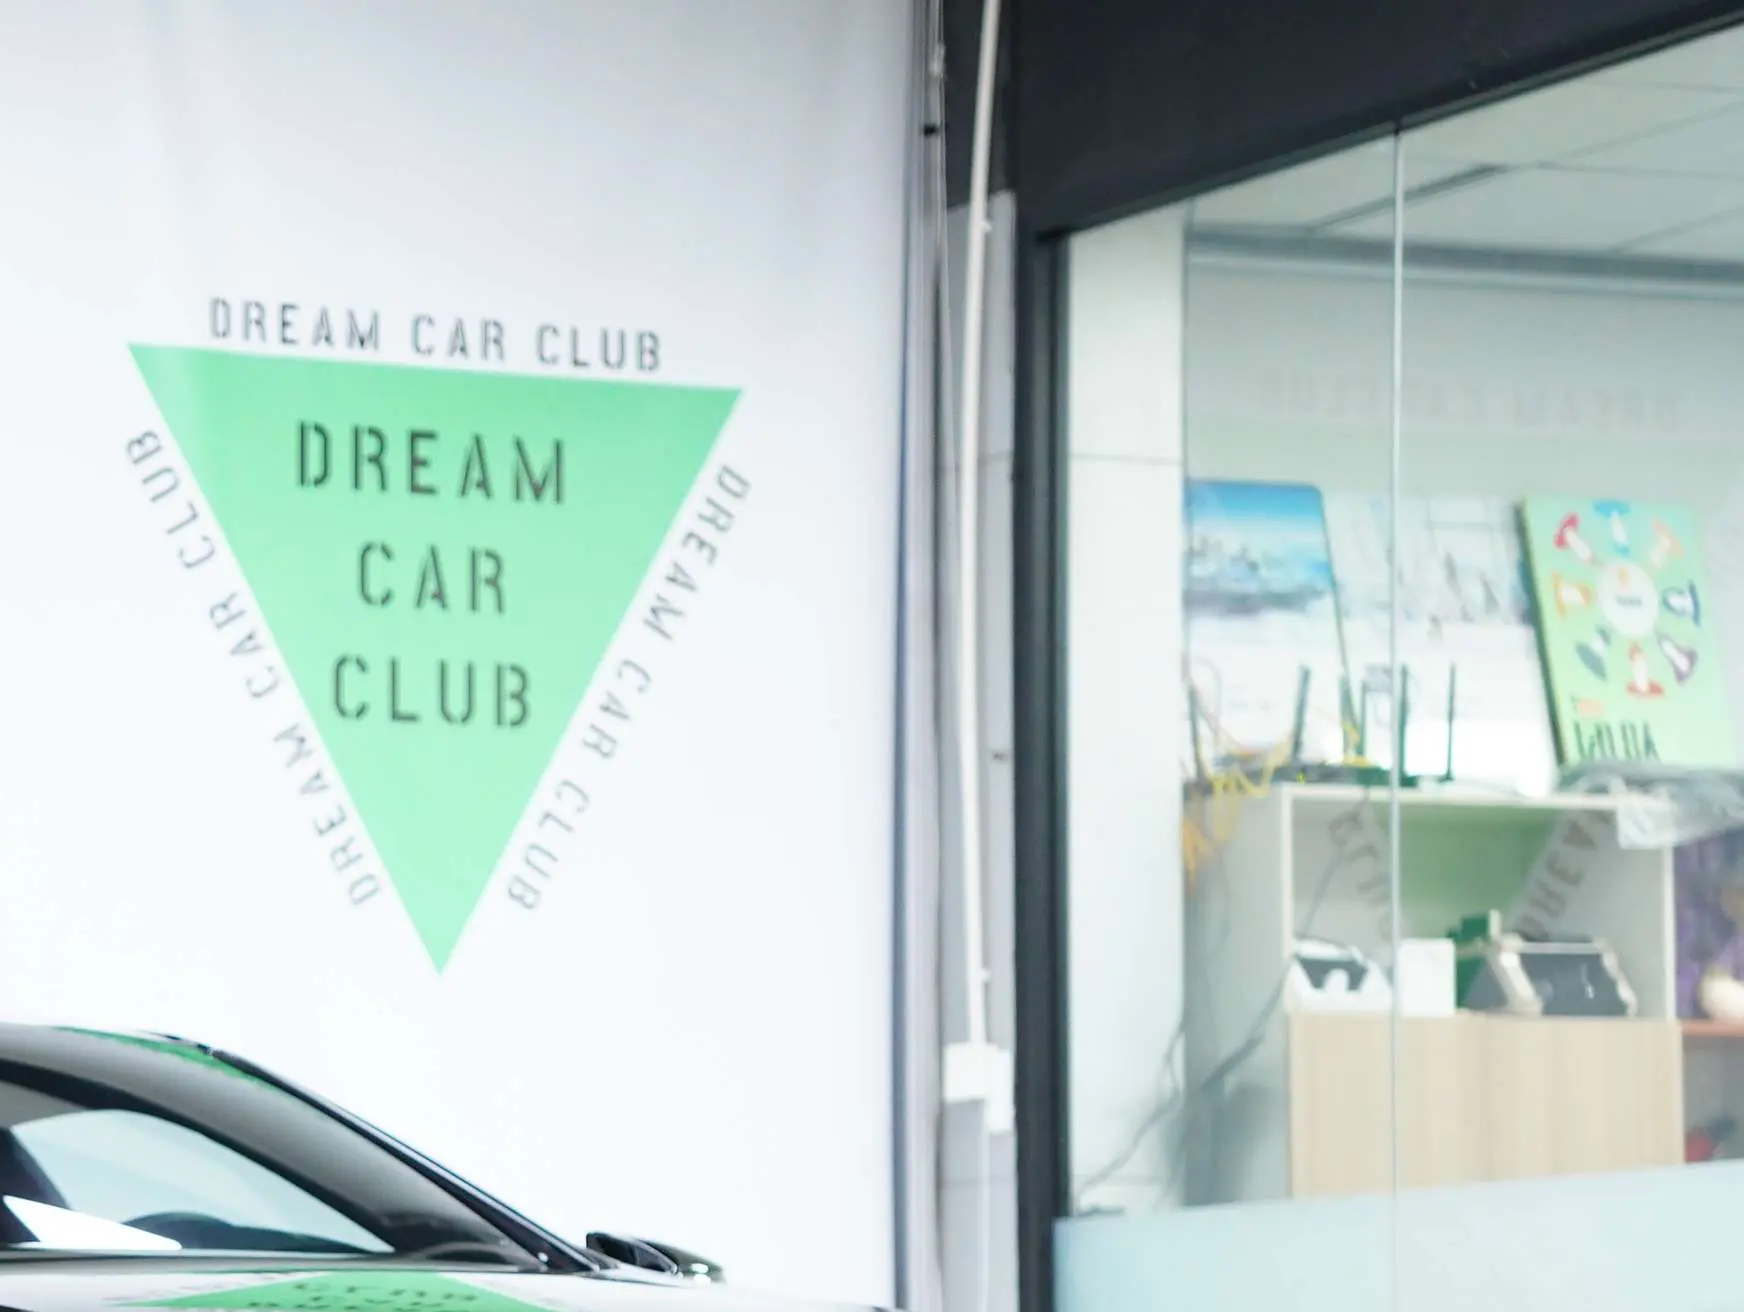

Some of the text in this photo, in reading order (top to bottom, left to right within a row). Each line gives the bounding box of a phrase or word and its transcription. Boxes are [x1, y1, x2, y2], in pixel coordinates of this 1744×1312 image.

[209, 296, 662, 373] DREAM CAR CLUB
[296, 420, 565, 506] DREAM
[357, 541, 507, 615] CAR
[125, 428, 382, 906] DREAM CAR CLUB
[332, 654, 530, 729] CLUB
[507, 463, 752, 911] DREAM CAR CLUB
